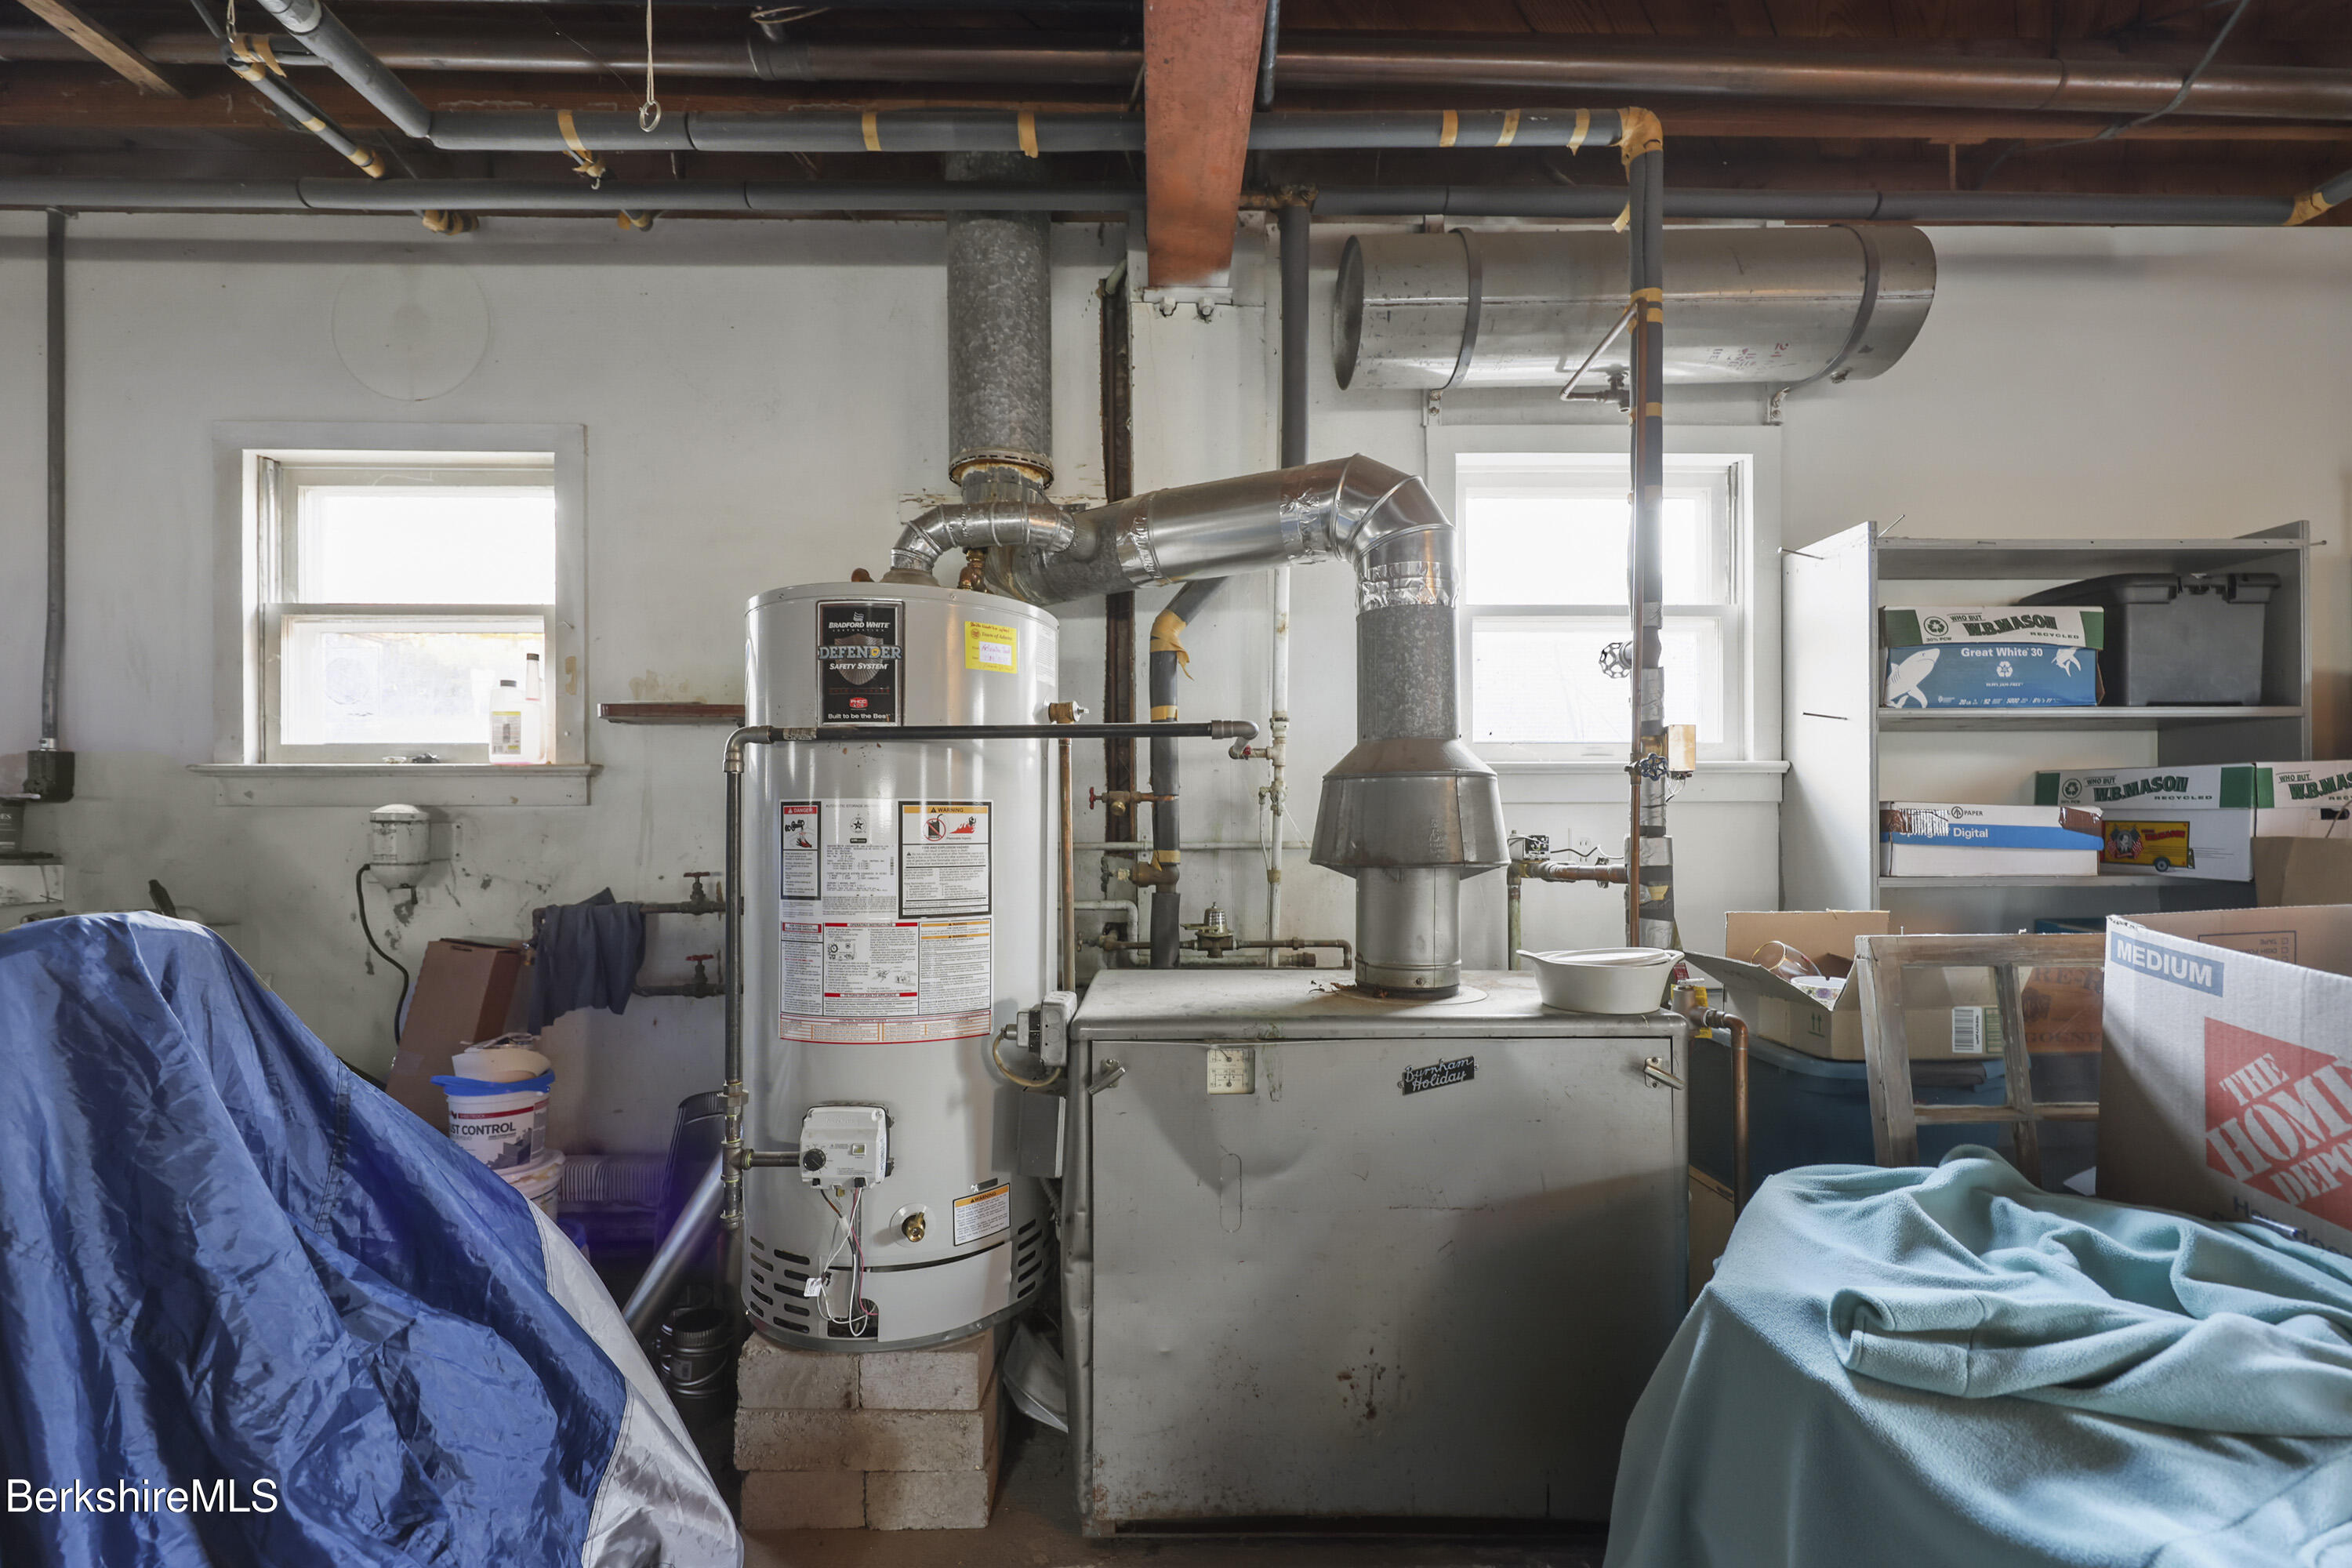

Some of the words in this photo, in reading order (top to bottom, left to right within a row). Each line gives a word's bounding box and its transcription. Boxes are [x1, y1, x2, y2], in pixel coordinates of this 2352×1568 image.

[1963, 615, 2058, 637] W.B.MASON
[818, 645, 902, 659] DEFENDER
[1961, 648, 1993, 657] Great
[1996, 647, 2028, 657] White
[2031, 648, 2043, 657] 30
[2092, 775, 2189, 802] W.B.MASON
[1953, 827, 1989, 840] Digital
[2117, 939, 2212, 987] MEDIUM
[1405, 1058, 1473, 1083] Burnham
[1412, 1071, 1467, 1091] Holiday
[2219, 1053, 2290, 1106] THE
[450, 1124, 460, 1135] ST
[461, 1121, 516, 1135] CONTROL
[2270, 1138, 2352, 1206] DEPO
[975, 1191, 996, 1202] WARNING
